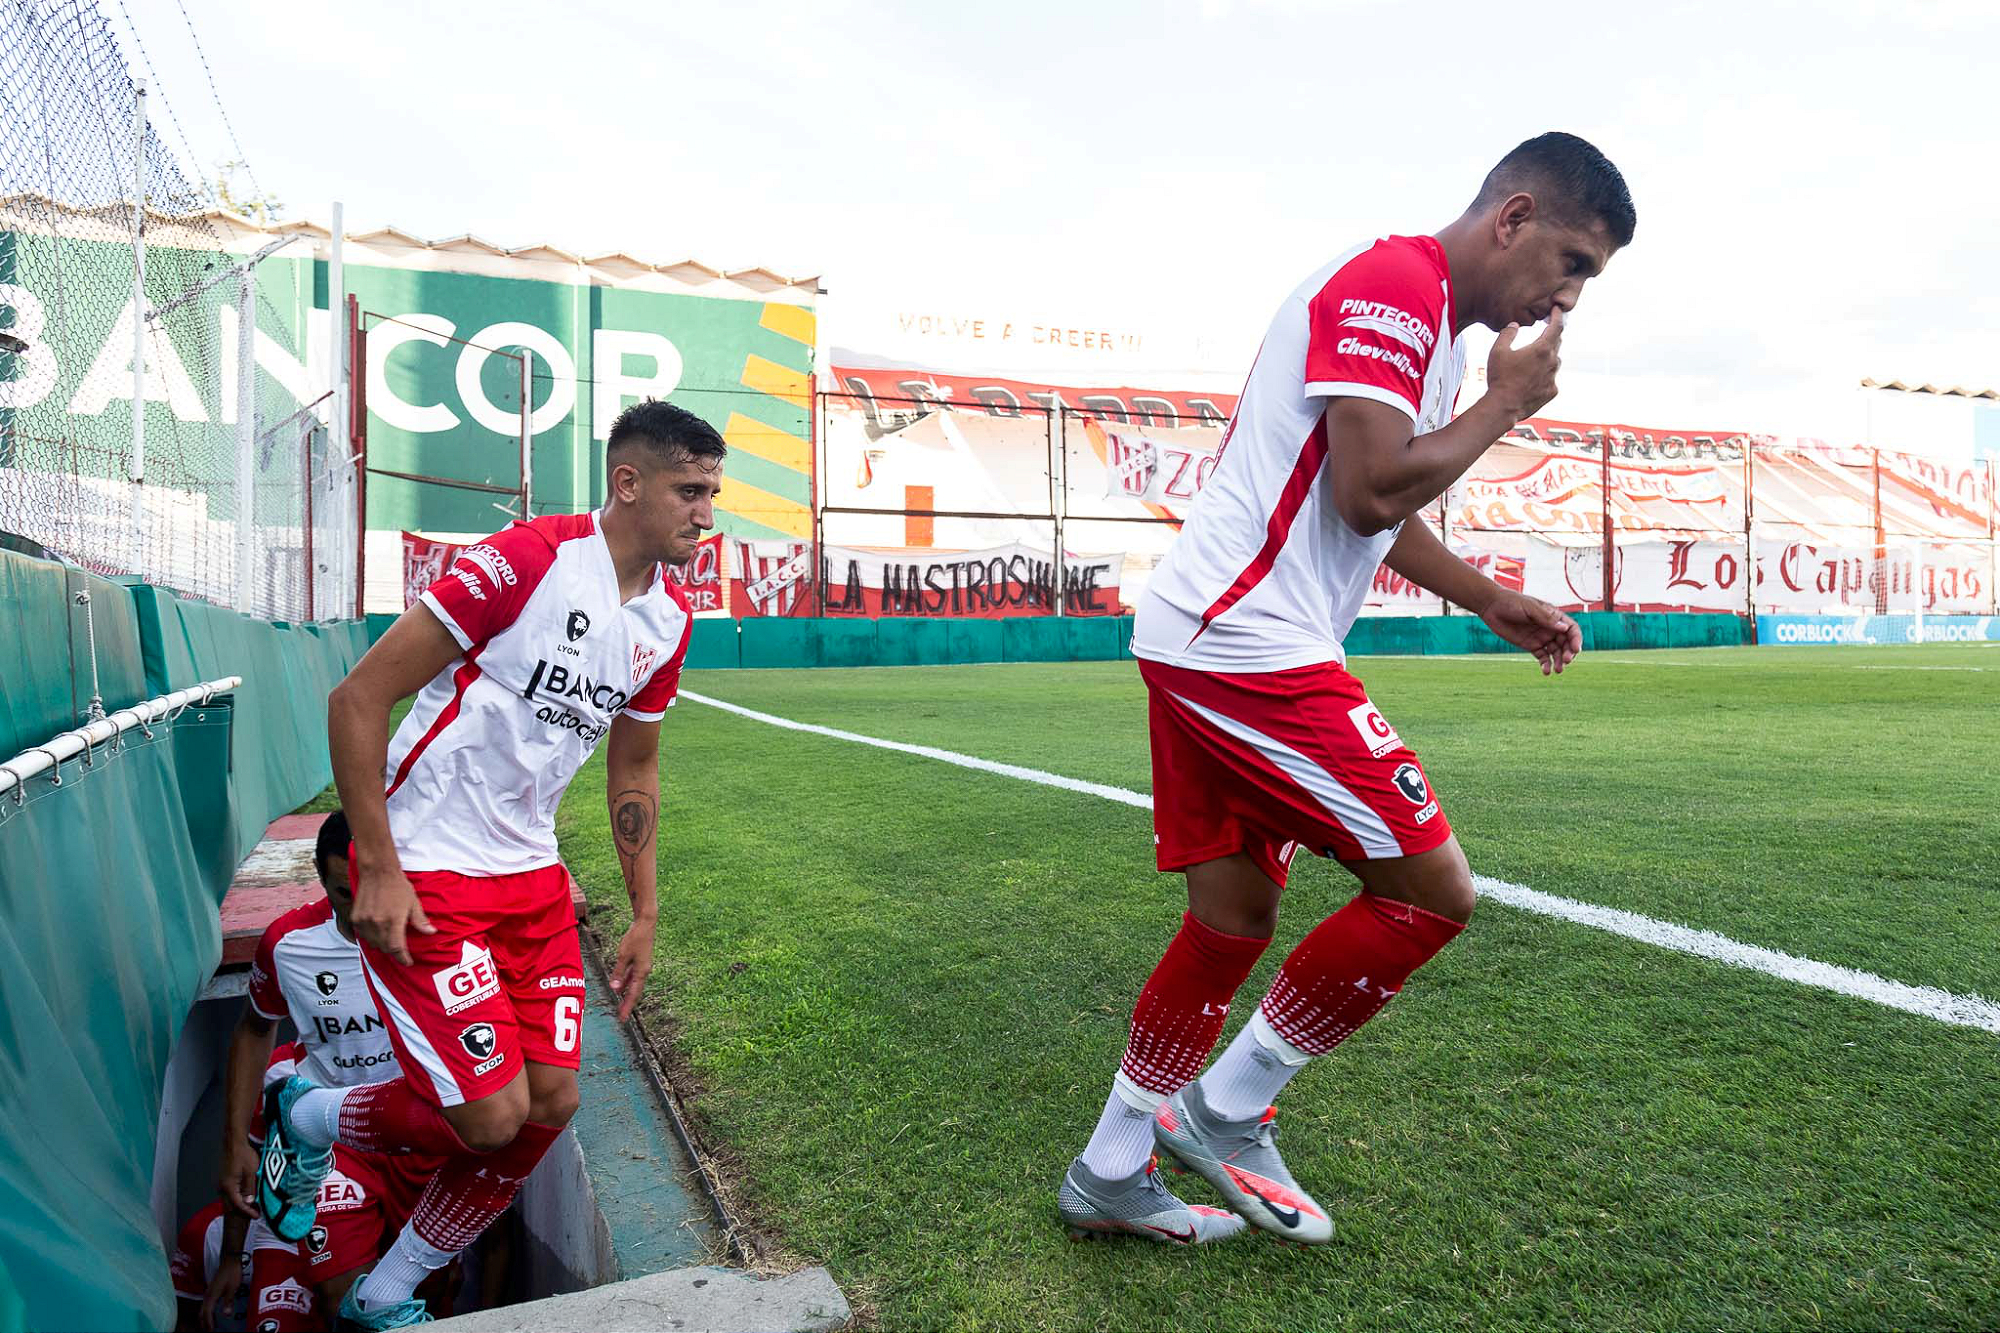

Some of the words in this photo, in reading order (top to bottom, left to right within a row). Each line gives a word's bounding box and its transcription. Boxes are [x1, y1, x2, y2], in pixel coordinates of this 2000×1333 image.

[899, 313, 985, 338] VOLVE
[1003, 324, 1012, 340] A
[0, 284, 683, 441] BANCOR
[1776, 623, 1852, 643] CORBLOCK
[1905, 623, 1978, 643] CRBLOCK
[556, 643, 581, 658] LYON
[318, 999, 339, 1007] LYON
[475, 1055, 504, 1075] LYON
[315, 1203, 337, 1213] TURA
